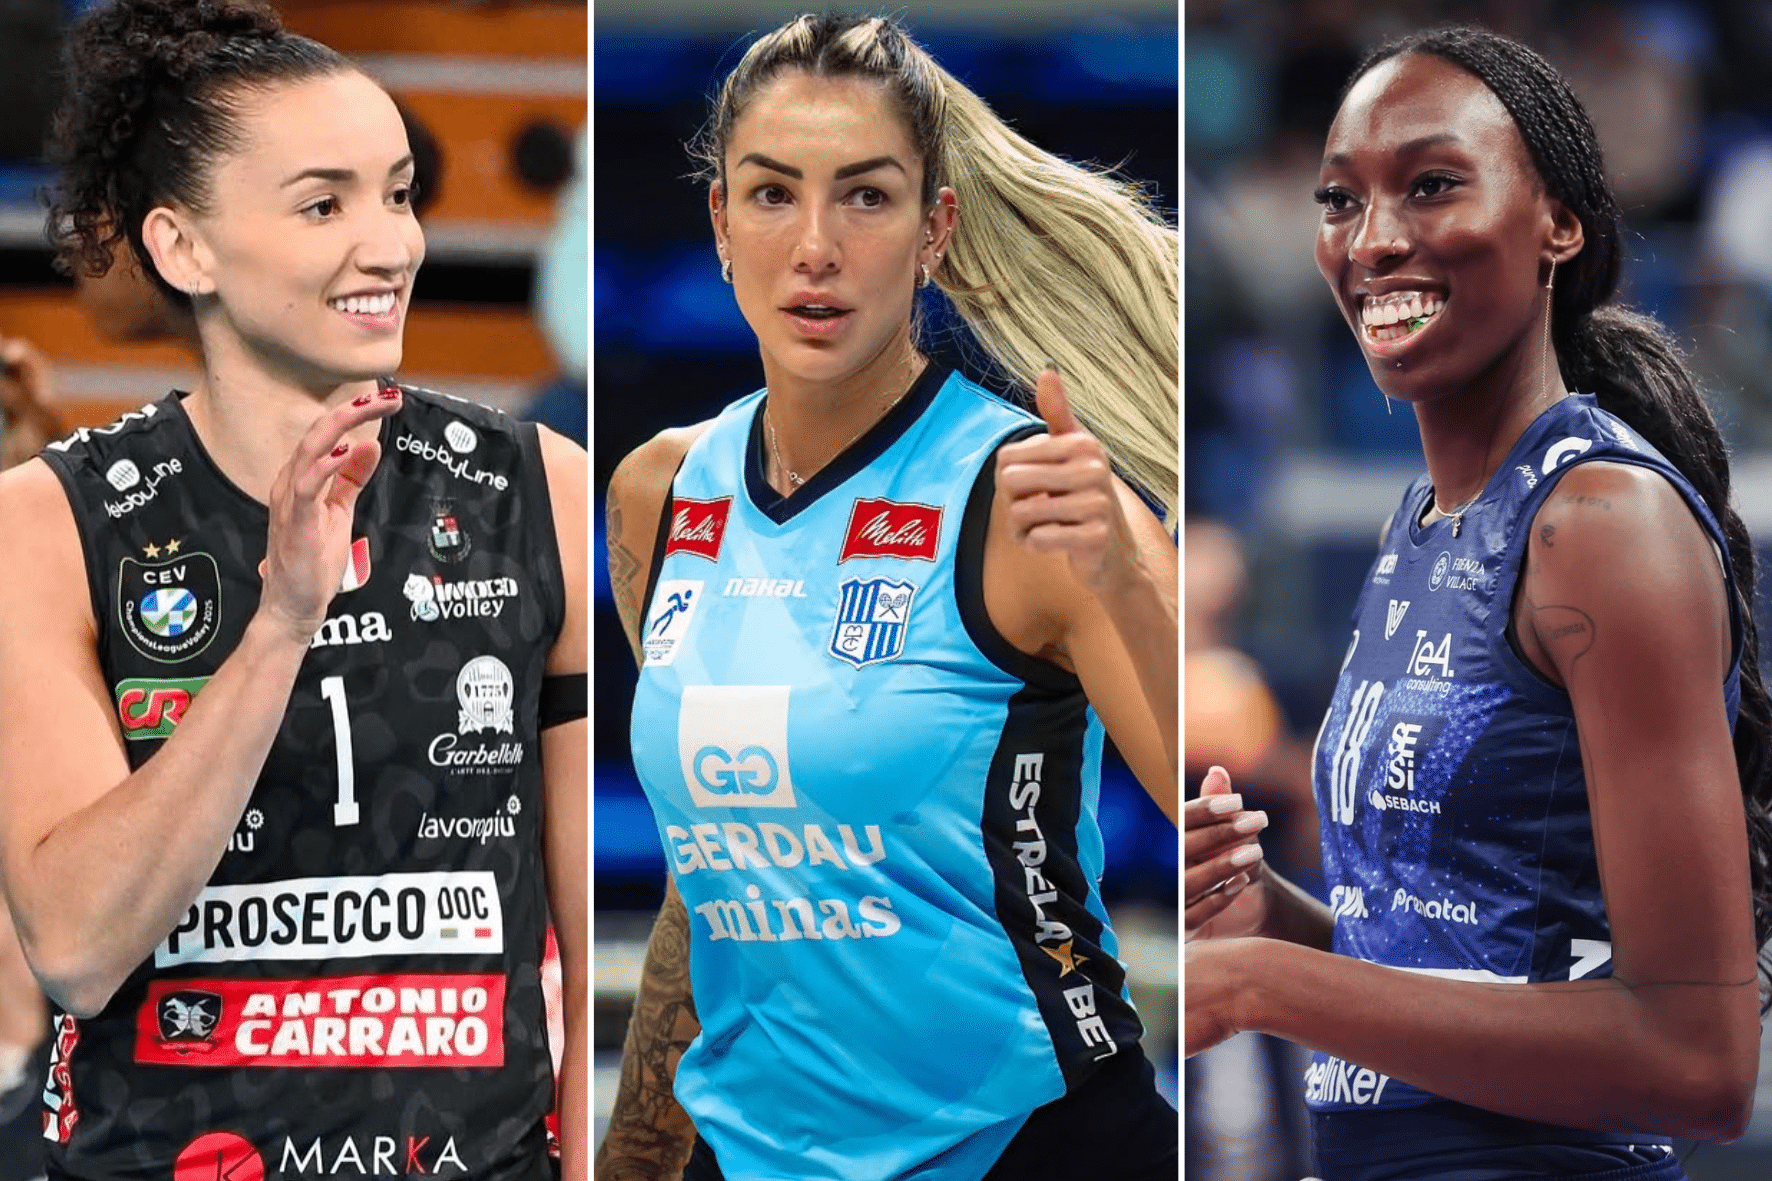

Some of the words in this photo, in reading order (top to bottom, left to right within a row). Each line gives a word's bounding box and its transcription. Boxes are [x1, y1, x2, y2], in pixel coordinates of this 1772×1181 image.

[854, 511, 928, 546] Melitta
[143, 565, 187, 584] CEV
[440, 598, 504, 619] Volley
[1406, 676, 1452, 698] consulting
[321, 676, 359, 826] 1
[1331, 680, 1384, 826] 18
[1384, 794, 1442, 814] SEBACH
[666, 822, 886, 875] GERDAU
[1009, 753, 1073, 943] ESTRELA
[167, 886, 426, 955] PROSECCO
[437, 885, 489, 920] DOC
[694, 883, 901, 942] minas
[241, 986, 488, 1017] ANTONIO
[234, 1016, 489, 1057] CARRARO
[279, 1135, 468, 1176] MARKA
